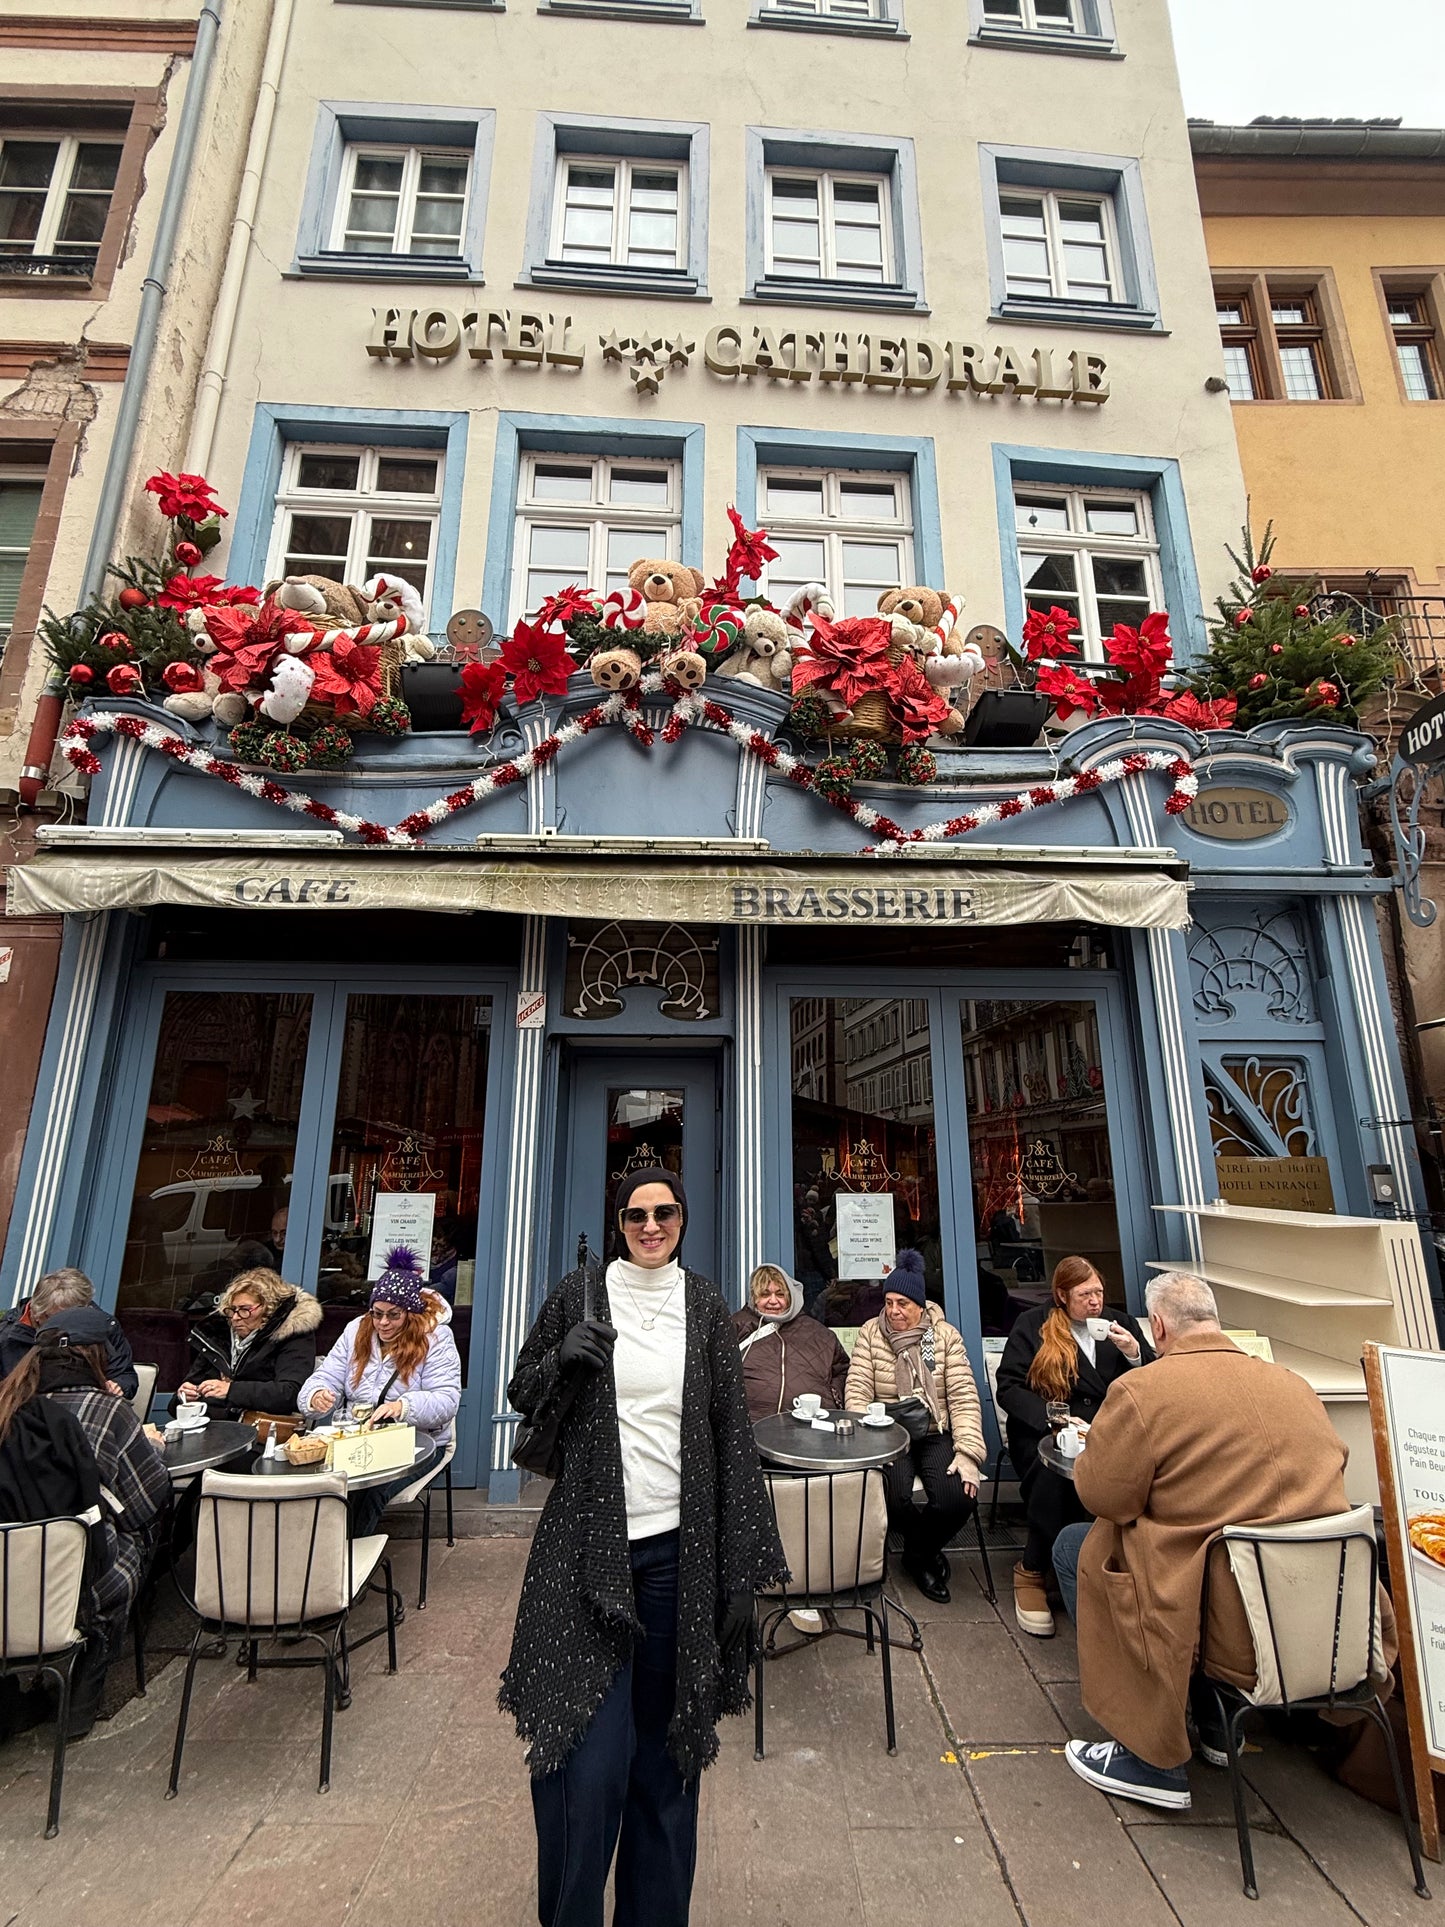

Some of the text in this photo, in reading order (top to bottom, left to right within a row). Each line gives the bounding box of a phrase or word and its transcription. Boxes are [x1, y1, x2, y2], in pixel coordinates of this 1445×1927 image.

[366, 307, 1111, 404] HOTEL CATHEDRALE
[1406, 709, 1445, 755] HOT
[1189, 800, 1284, 825] HOTEL
[235, 877, 358, 903] CAFE
[732, 886, 977, 920] BRASSERIE
[518, 997, 544, 1022] LICENCE
[201, 1155, 231, 1165] CAFÉ
[392, 1156, 421, 1166] CAFÉ
[850, 1158, 877, 1168] CAFÉ
[1026, 1159, 1054, 1169] CAFÉ
[1260, 1181, 1320, 1190] ENTRANCE
[1408, 1428, 1436, 1442] Chaque
[1404, 1442, 1438, 1456] dégustez
[1410, 1457, 1426, 1468] Pain
